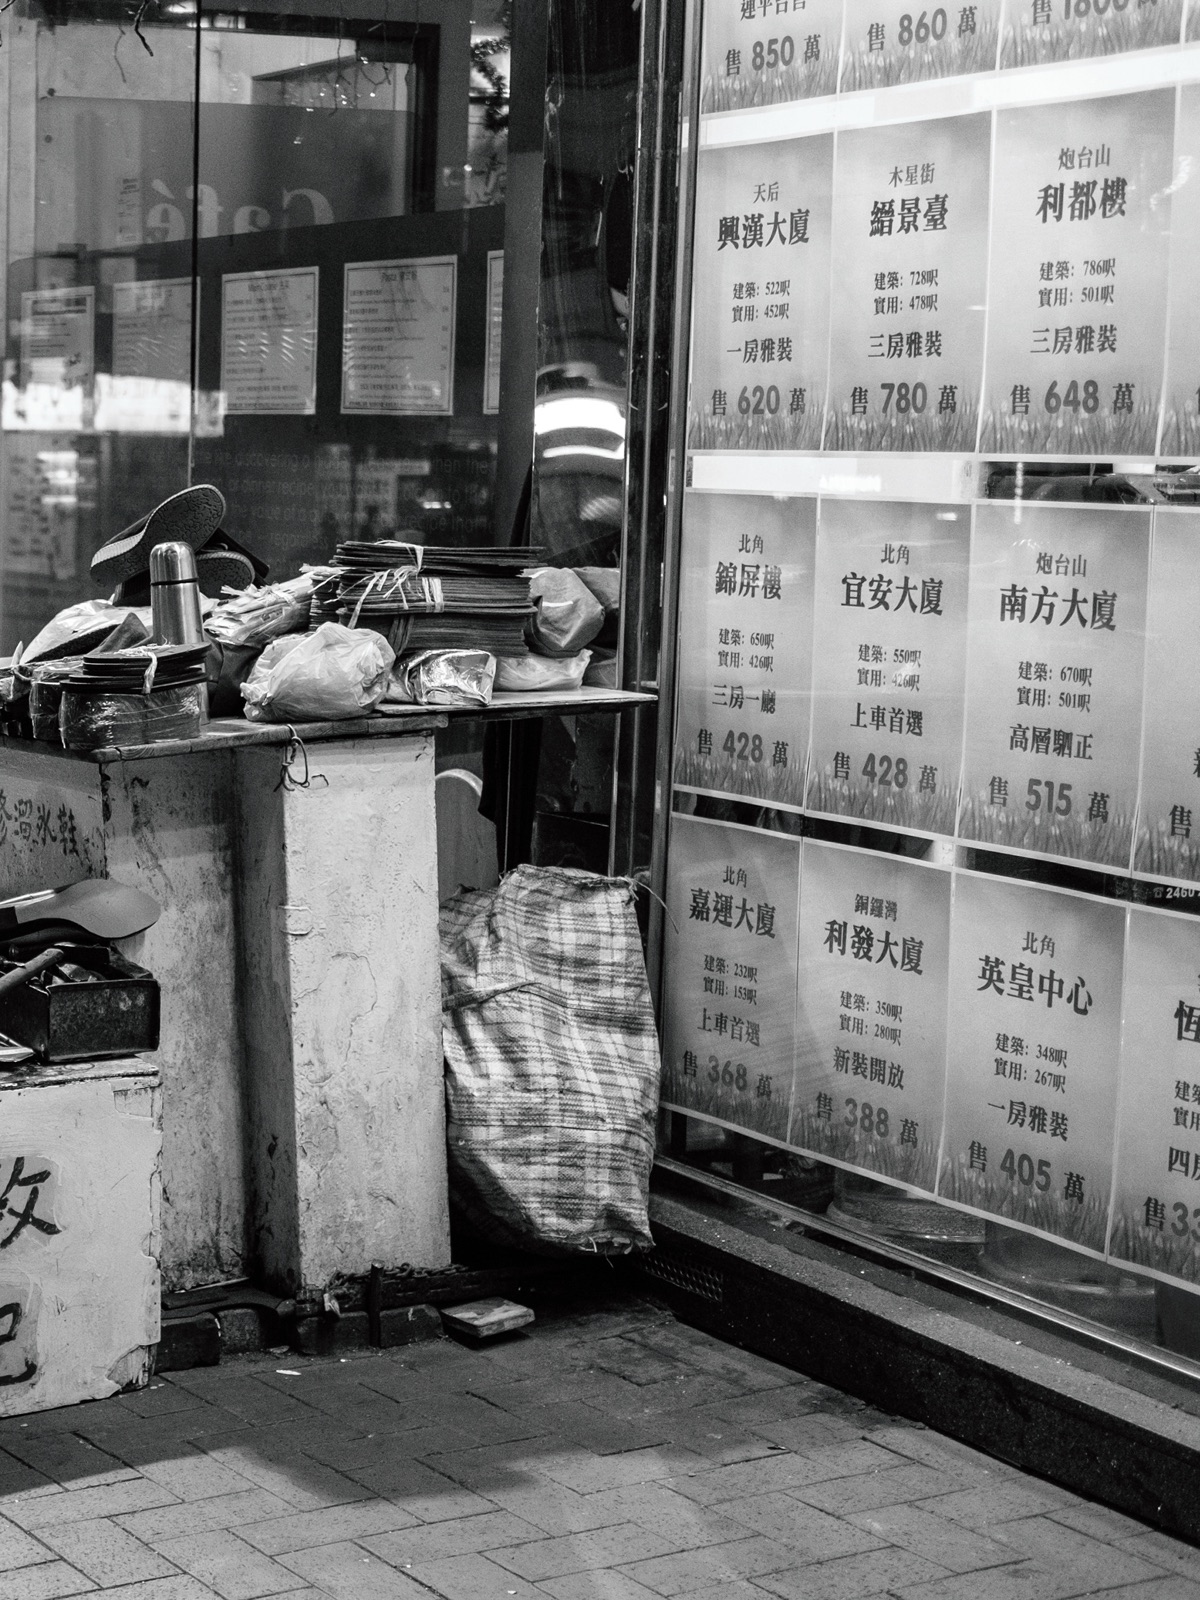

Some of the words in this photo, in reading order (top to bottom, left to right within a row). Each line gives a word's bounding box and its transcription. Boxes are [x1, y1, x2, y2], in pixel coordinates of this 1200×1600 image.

[867, 22, 886, 53] 售
[897, 7, 948, 47] 860
[957, 5, 978, 39] 萬
[725, 48, 742, 78] 售
[751, 35, 795, 73] 850
[803, 34, 821, 65] 萬
[889, 162, 935, 188] 木星街
[1058, 143, 1111, 170] 炮台山
[753, 181, 780, 204] 天后
[1036, 176, 1128, 224] 利都樓
[717, 208, 810, 251] 興漢大廈
[726, 336, 793, 363] 一房雅裝
[868, 330, 942, 359] 三房雅裝
[1030, 323, 1118, 354] 三房雅裝
[711, 389, 727, 417] 售
[737, 384, 781, 417] 620
[789, 387, 807, 416] 萬
[850, 386, 869, 416] 售
[880, 382, 928, 418] 780
[938, 384, 958, 415] 萬
[1010, 384, 1031, 416] 售
[1044, 379, 1100, 415] 648
[1112, 382, 1135, 417] 萬
[738, 533, 764, 555] 北角
[880, 543, 910, 566] 北角
[714, 561, 782, 600] 錦屏樓
[1036, 552, 1088, 578] 炮台山
[840, 571, 944, 616] 宜安大廈
[1000, 583, 1118, 632] 南方大廈
[711, 684, 776, 715] 三房一廳
[850, 702, 923, 737] 上車首選
[697, 728, 713, 756] 售
[722, 729, 764, 765] 428
[772, 740, 789, 769] 萬
[833, 751, 851, 781] 售
[861, 752, 908, 790] 428
[918, 764, 938, 795] 萬
[988, 775, 1009, 808] 售
[1025, 778, 1073, 818] 515
[1087, 791, 1110, 824] 萬
[1169, 804, 1192, 839] 售
[722, 865, 748, 889] 北角
[688, 887, 776, 939] 嘉運大廈
[854, 893, 898, 923] 銅鑼灣
[823, 919, 924, 976] 利發大廈
[1021, 931, 1056, 959] 北角
[977, 954, 1094, 1016] 英皇中心
[697, 1007, 760, 1047] 上車首選
[682, 1050, 698, 1078] 售
[706, 1055, 749, 1093] 368
[755, 1074, 773, 1102] 萬
[833, 1046, 905, 1091] 新裝開放
[814, 1091, 834, 1123] 售
[843, 1097, 890, 1140] 388
[899, 1118, 919, 1150] 萬
[988, 1099, 1069, 1142] 一房雅裝
[968, 1140, 988, 1173] 售
[998, 1148, 1052, 1193] 405
[1063, 1171, 1085, 1205] 萬
[1143, 1196, 1166, 1232] 售
